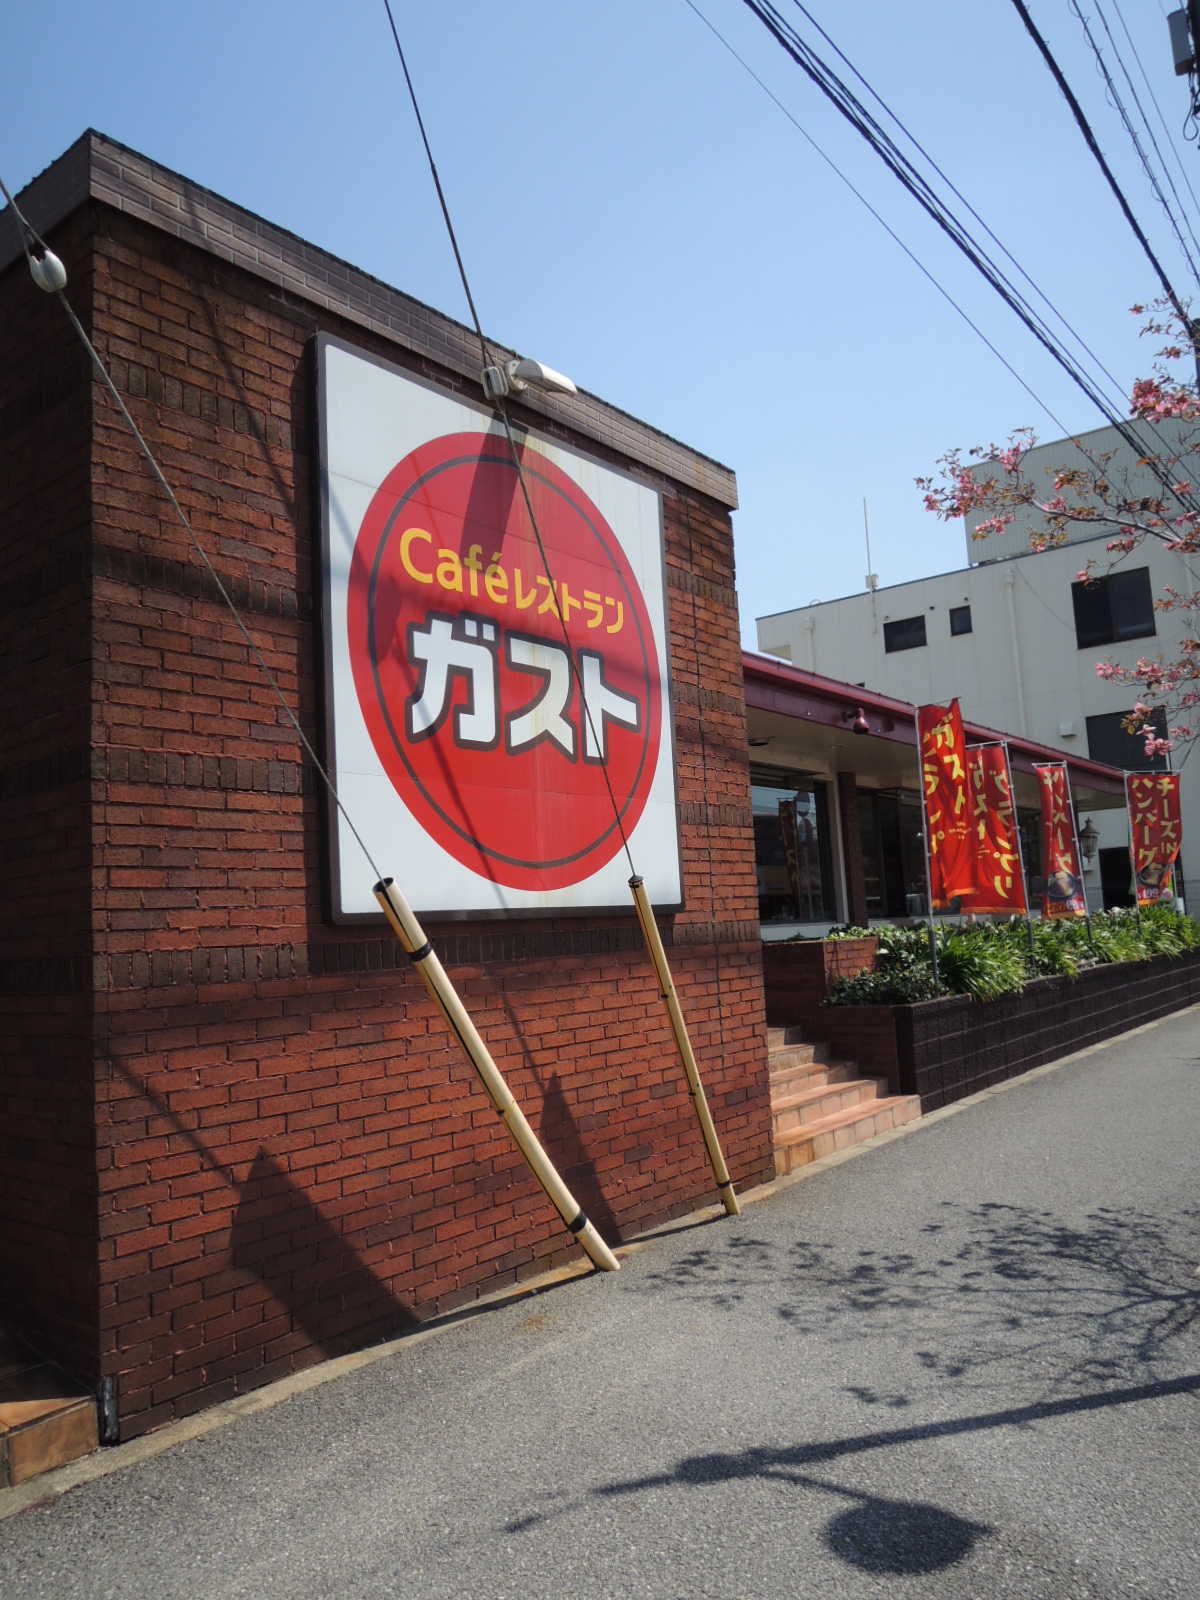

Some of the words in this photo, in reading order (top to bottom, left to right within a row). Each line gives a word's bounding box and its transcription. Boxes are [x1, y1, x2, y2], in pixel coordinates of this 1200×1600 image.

[407, 613, 641, 763] ガスト
[932, 712, 966, 814] ガスト
[1132, 778, 1158, 869] ハンバーグ
